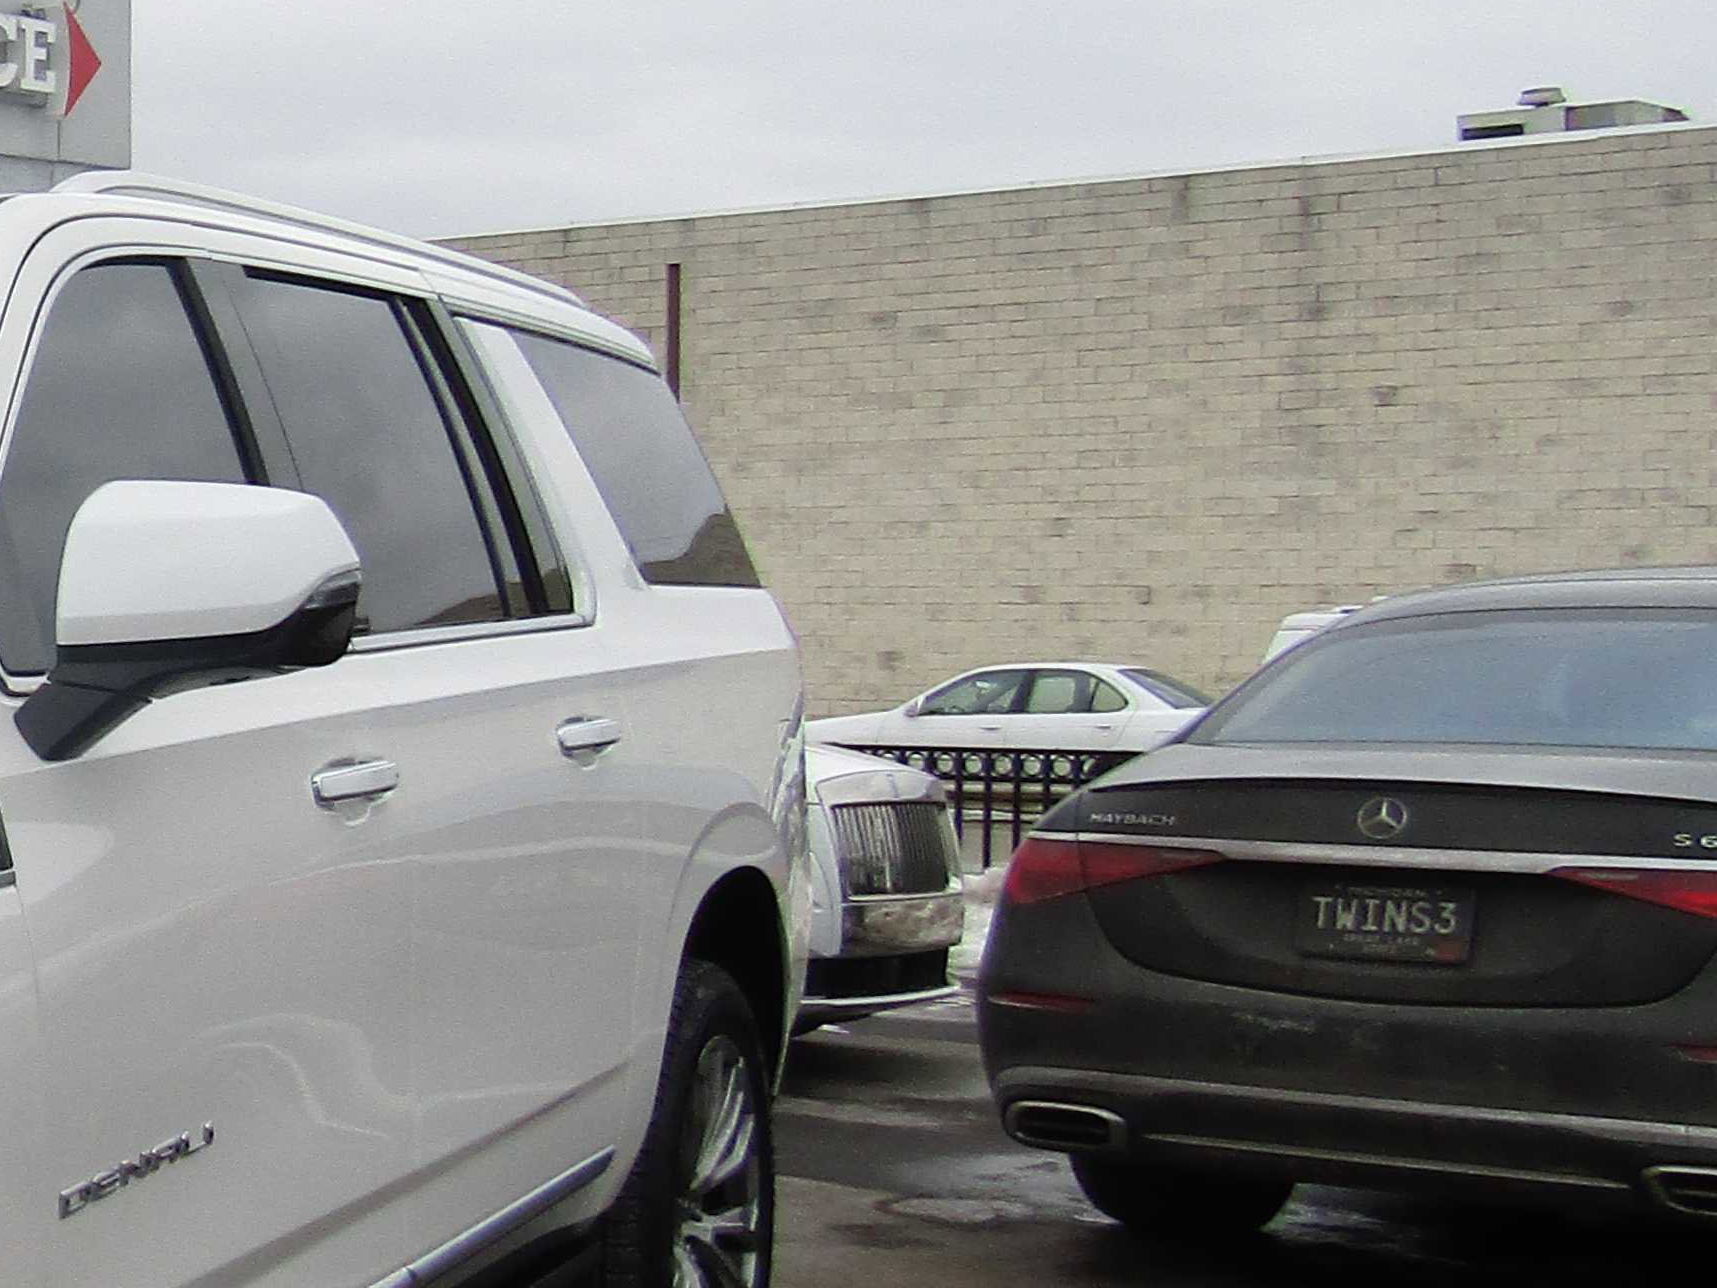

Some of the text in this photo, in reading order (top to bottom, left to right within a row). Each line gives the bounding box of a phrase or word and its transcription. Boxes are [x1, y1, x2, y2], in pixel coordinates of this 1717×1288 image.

[1091, 813, 1175, 826] MAYBACH
[1673, 833, 1692, 847] S
[1312, 896, 1458, 934] TWINS3
[58, 1120, 214, 1220] DENALI
